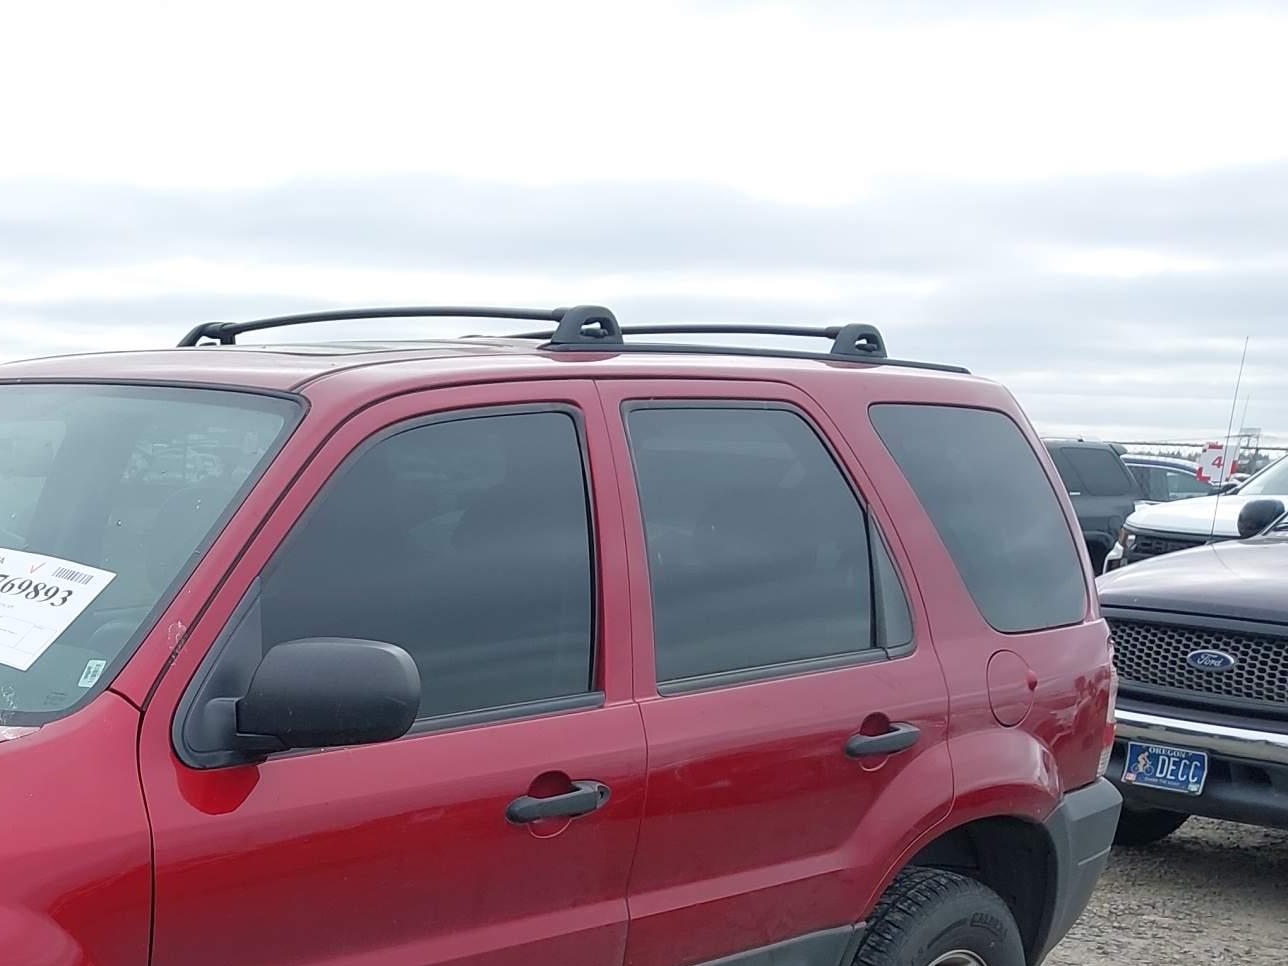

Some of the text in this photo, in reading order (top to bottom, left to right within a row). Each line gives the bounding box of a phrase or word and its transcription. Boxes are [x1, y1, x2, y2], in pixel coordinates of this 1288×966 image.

[1196, 653, 1224, 667] Ford
[1148, 746, 1187, 758] OREGON
[1155, 755, 1201, 783] DECC
